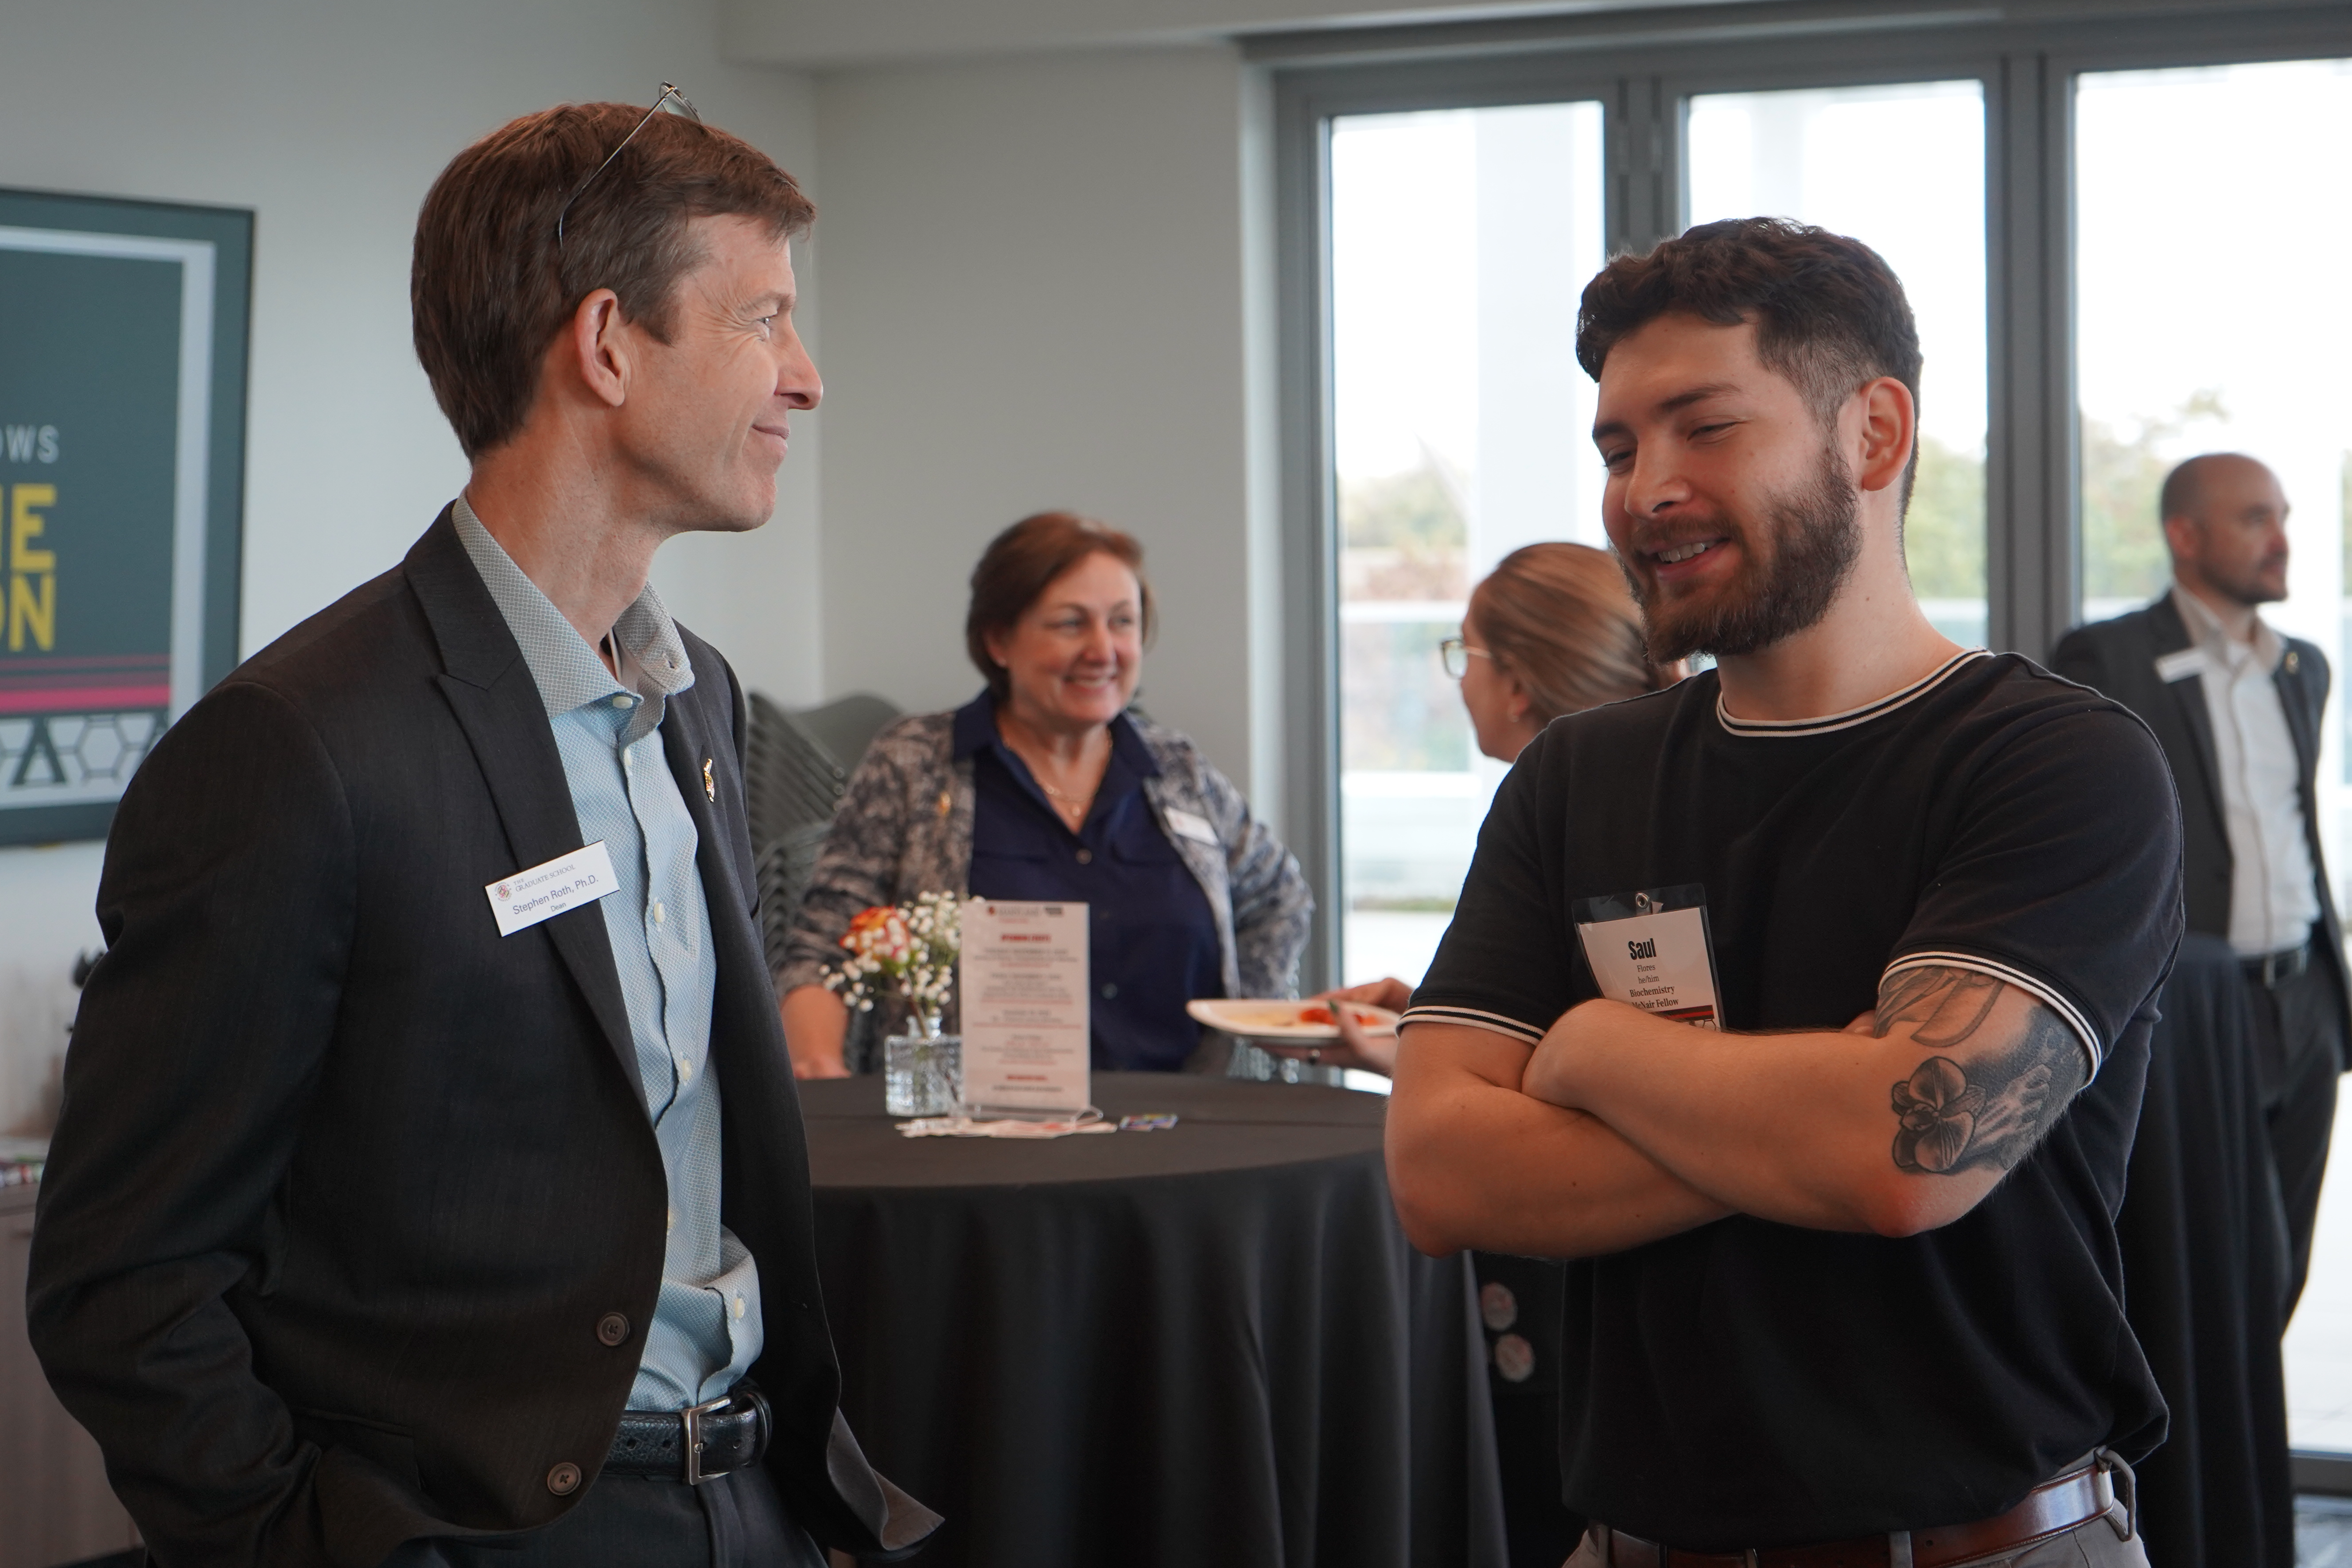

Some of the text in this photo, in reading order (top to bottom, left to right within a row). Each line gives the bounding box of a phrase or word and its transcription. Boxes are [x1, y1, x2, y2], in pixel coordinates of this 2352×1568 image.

[0, 424, 59, 464] WS
[0, 483, 57, 574] E
[0, 574, 56, 653] N
[515, 874, 549, 892] GRADUATE
[549, 864, 575, 879] SCHOOL
[513, 874, 599, 915] Stephen Roth, Ph.D.
[551, 902, 567, 912] Dean
[1628, 938, 1657, 960] Saul
[1629, 986, 1675, 997] Biochemistry
[1638, 975, 1660, 984] he/him
[1656, 998, 1679, 1008] Fellow
